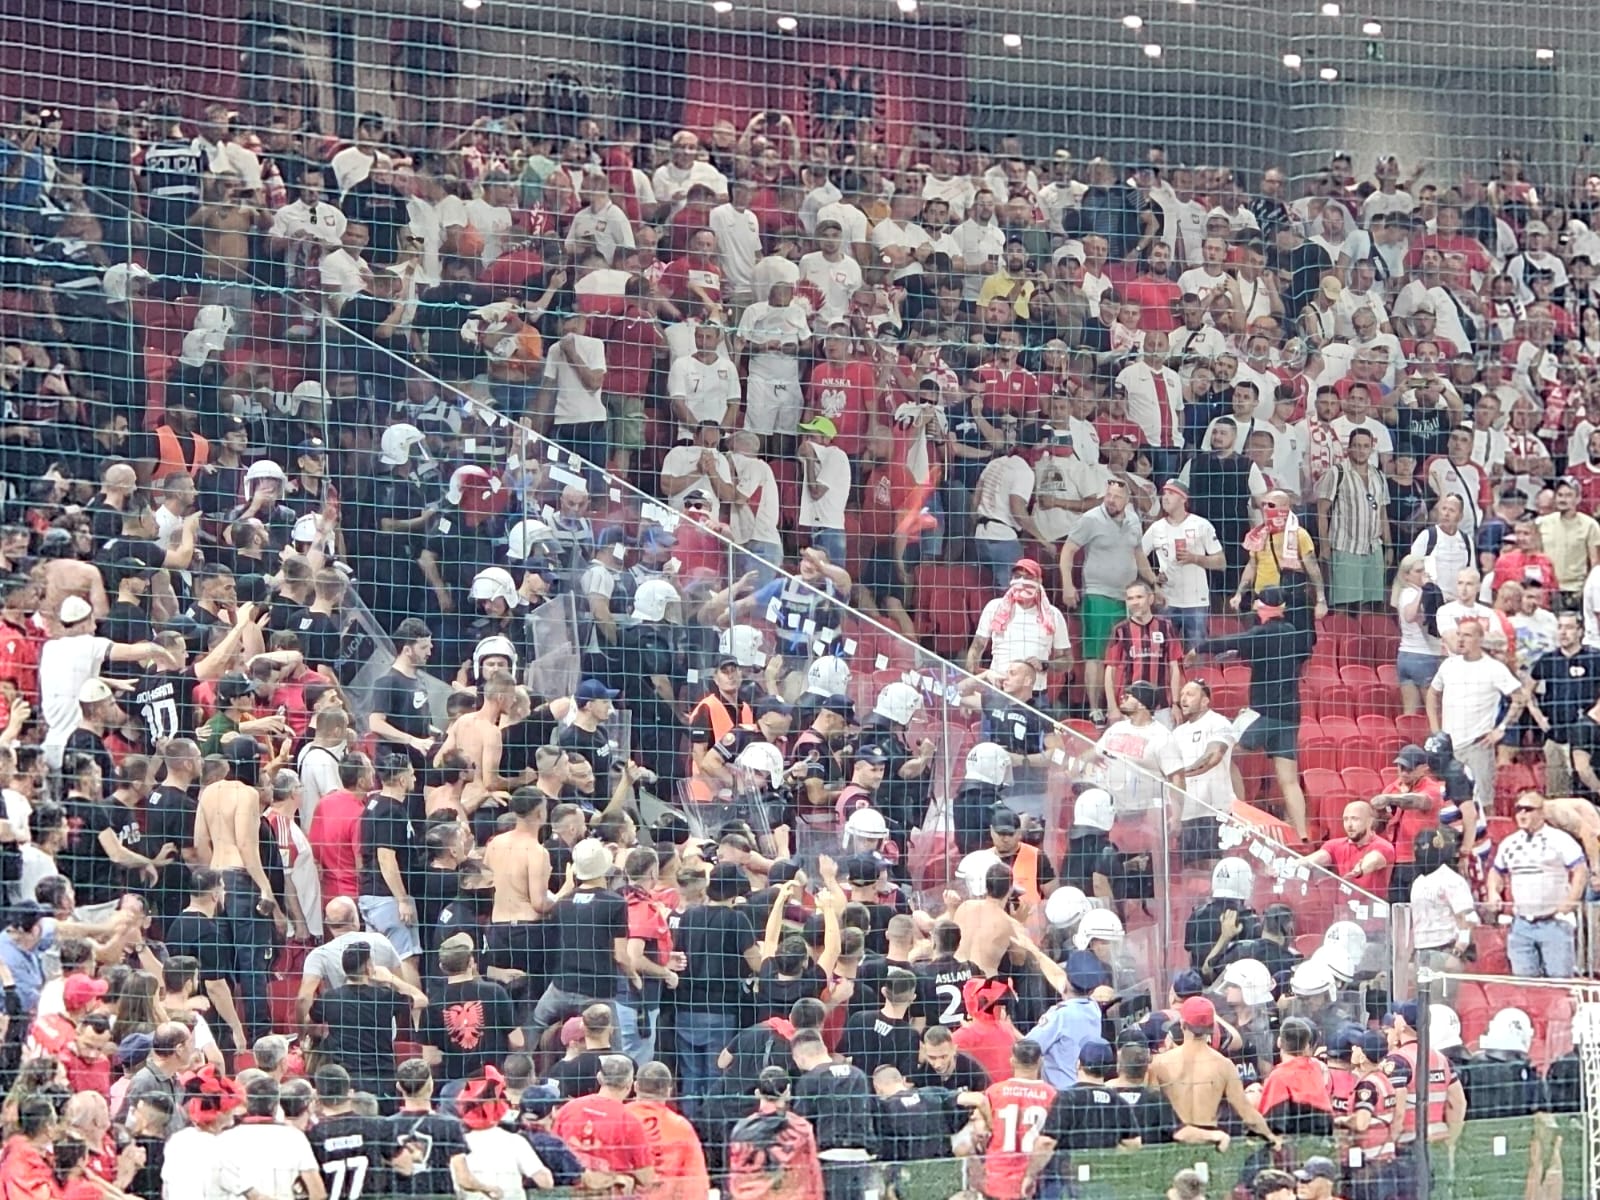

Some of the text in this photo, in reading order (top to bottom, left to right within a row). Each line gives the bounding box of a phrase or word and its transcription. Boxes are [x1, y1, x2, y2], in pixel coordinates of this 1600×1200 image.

[693, 379, 700, 393] 7
[822, 378, 851, 387] POLSKA
[141, 698, 178, 747] 10
[322, 1155, 369, 1200] 77
